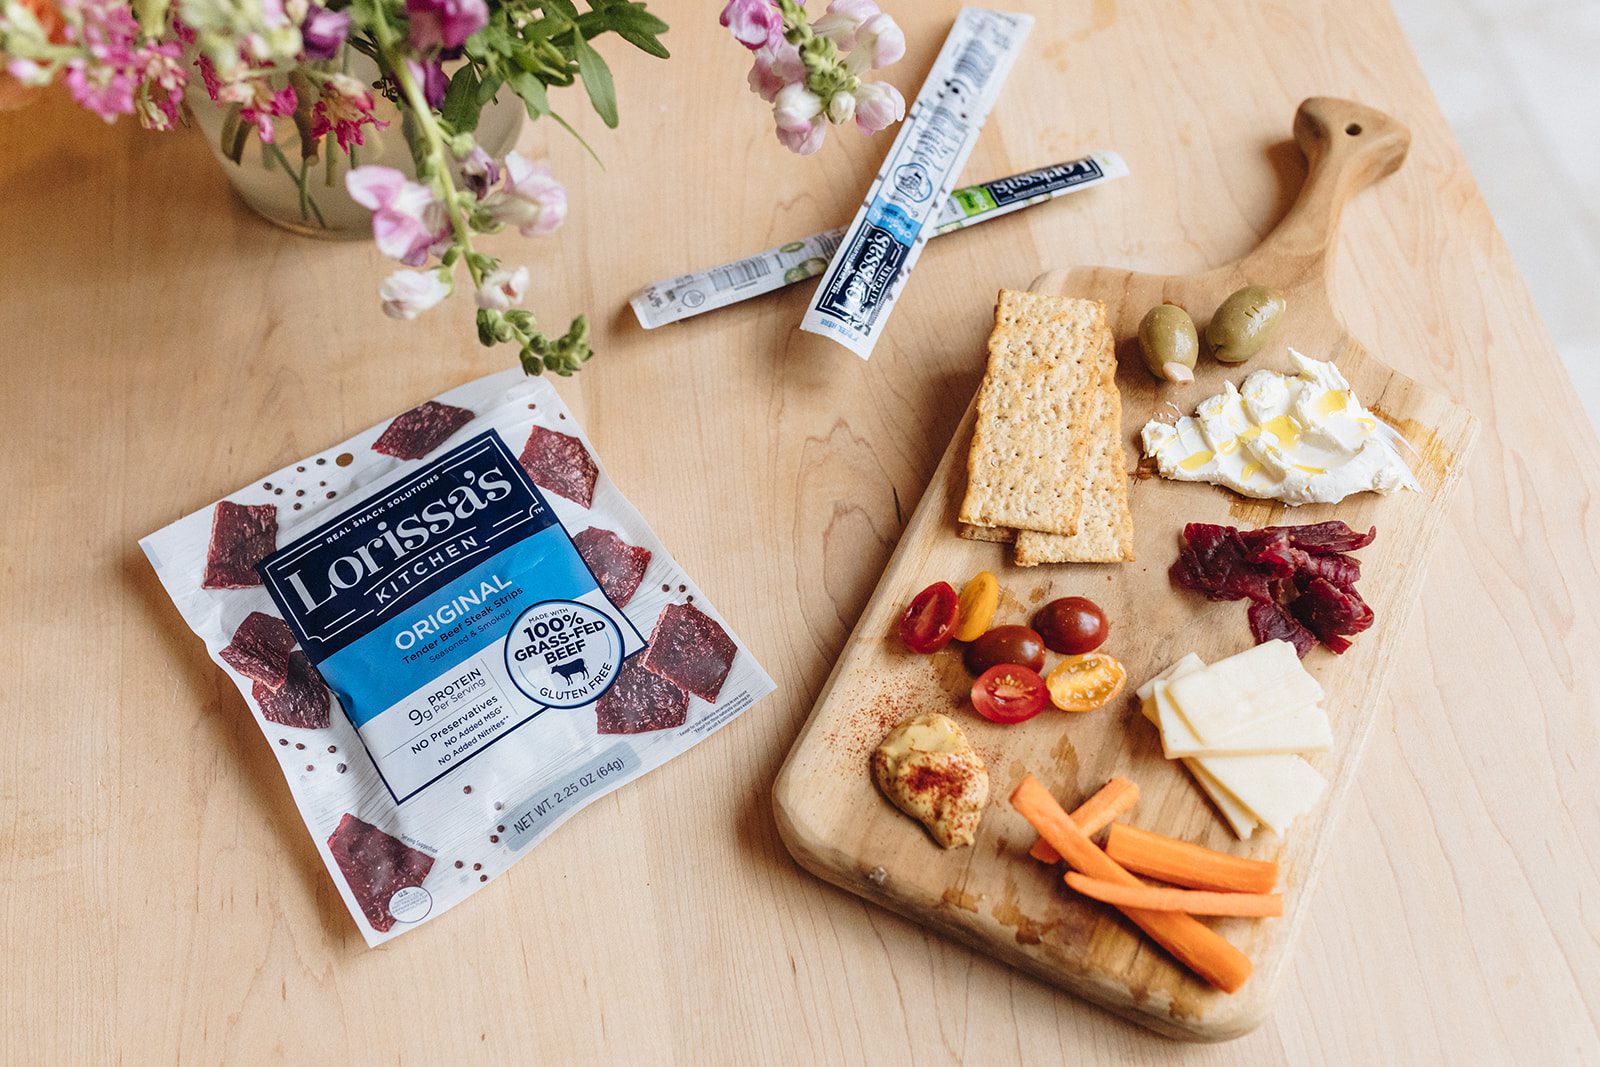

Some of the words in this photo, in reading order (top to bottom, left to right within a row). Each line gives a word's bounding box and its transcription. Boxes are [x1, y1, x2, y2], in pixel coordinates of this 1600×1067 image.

[869, 264, 893, 304] KITCHEN
[326, 525, 352, 544] REAL
[352, 507, 385, 528] SNACK
[387, 474, 440, 508] SOLUTIONS
[284, 466, 512, 615] Lorissa's
[375, 535, 479, 604] KITCHEN
[395, 574, 513, 650] ORIGINAL
[402, 639, 439, 664] Tender
[440, 623, 464, 642] Beef
[464, 605, 494, 626] Steak
[493, 587, 524, 608] Strips
[523, 611, 585, 642] 100%
[528, 612, 548, 624] MADE
[549, 608, 569, 617] WITH
[429, 635, 469, 664] Seasoned
[477, 608, 512, 633] Smoked
[514, 620, 606, 661] GRASS-FED
[543, 639, 586, 664] BEEF
[408, 708, 433, 726] 9g
[433, 701, 449, 714] Per
[450, 678, 487, 703] Serving
[427, 667, 482, 706] PROTEIN
[539, 686, 588, 701] GLUTEN
[588, 662, 613, 690] FREE
[411, 739, 429, 755] NO
[430, 695, 498, 742] Preservatives
[443, 735, 458, 748] NO
[458, 719, 483, 739] Added
[437, 753, 452, 765] NO
[453, 736, 478, 756] Added
[513, 811, 535, 834] NET
[533, 797, 555, 817] WT.
[553, 783, 579, 803] 2.25
[579, 773, 597, 788] OZ
[596, 757, 625, 779] (64g)
